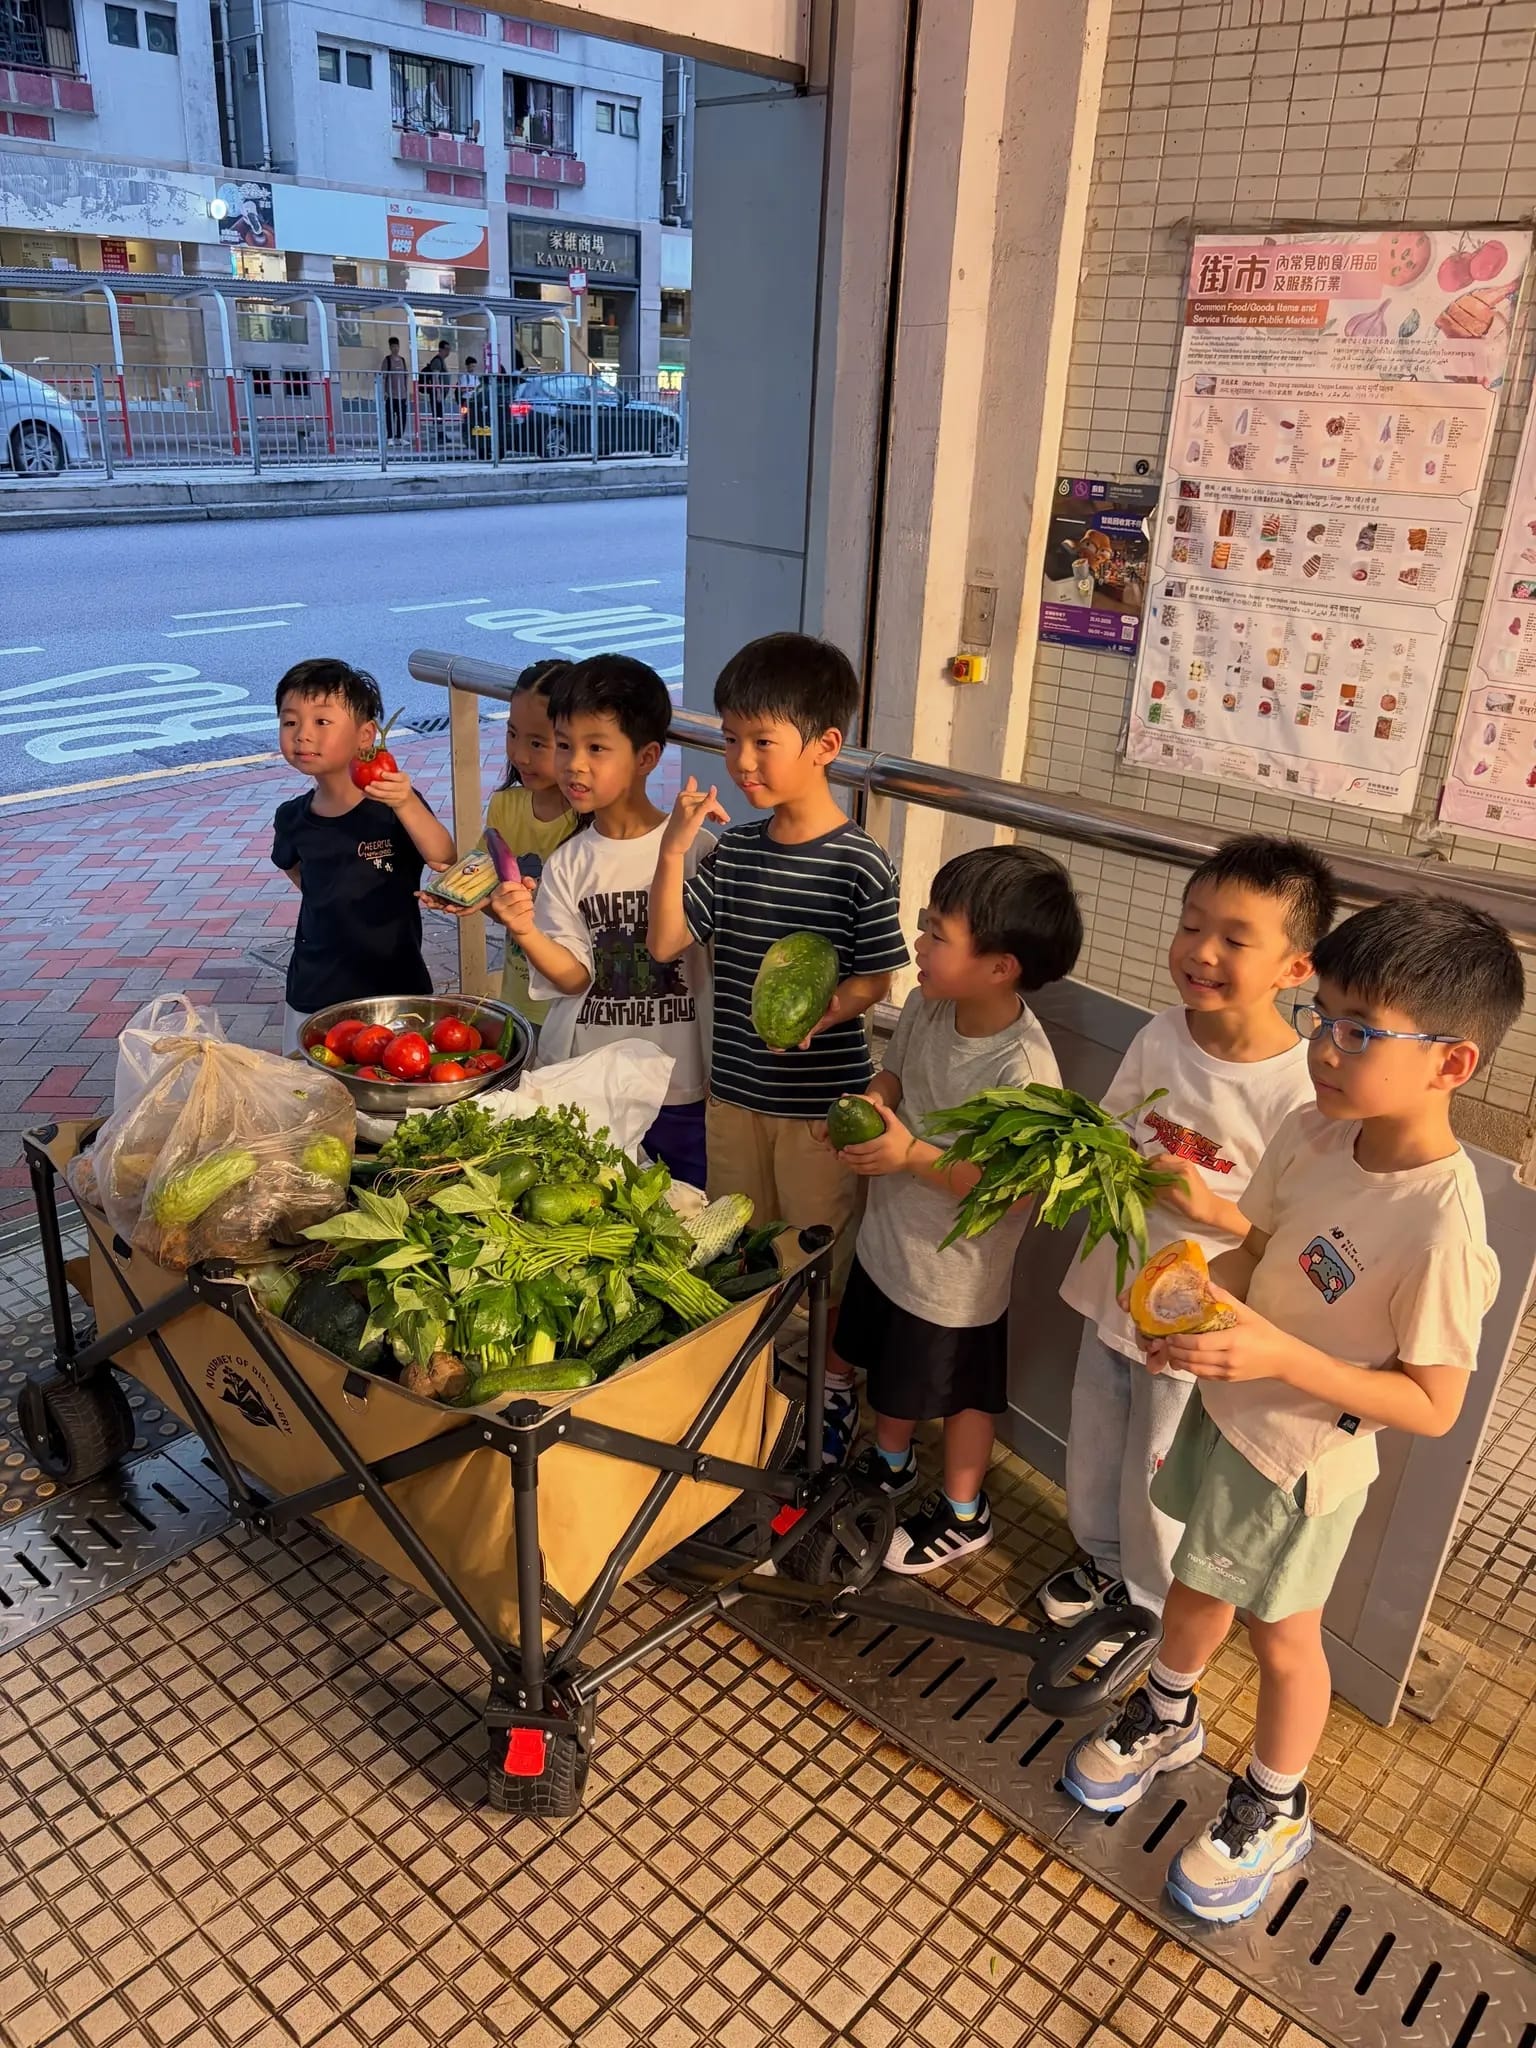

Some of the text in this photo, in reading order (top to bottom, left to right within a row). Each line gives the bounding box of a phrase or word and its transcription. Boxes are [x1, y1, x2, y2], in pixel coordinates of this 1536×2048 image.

[549, 231, 604, 254] 家維商場
[536, 252, 617, 273] KA WAI PLAZA
[1198, 254, 1270, 293] 街市
[1272, 275, 1341, 293] 及服務行業
[1194, 303, 1317, 312] Common Food/Goods Items and
[1192, 316, 1220, 325] Service
[1222, 316, 1247, 324] Trades
[1258, 317, 1282, 326] Public
[1285, 317, 1318, 325] Markets
[578, 890, 649, 929] MINECR
[576, 997, 696, 1027] DVENTURE CLUB
[205, 1354, 232, 1382] JOURNEY
[236, 1356, 249, 1367] OF
[1187, 1552, 1247, 1585] new balance
